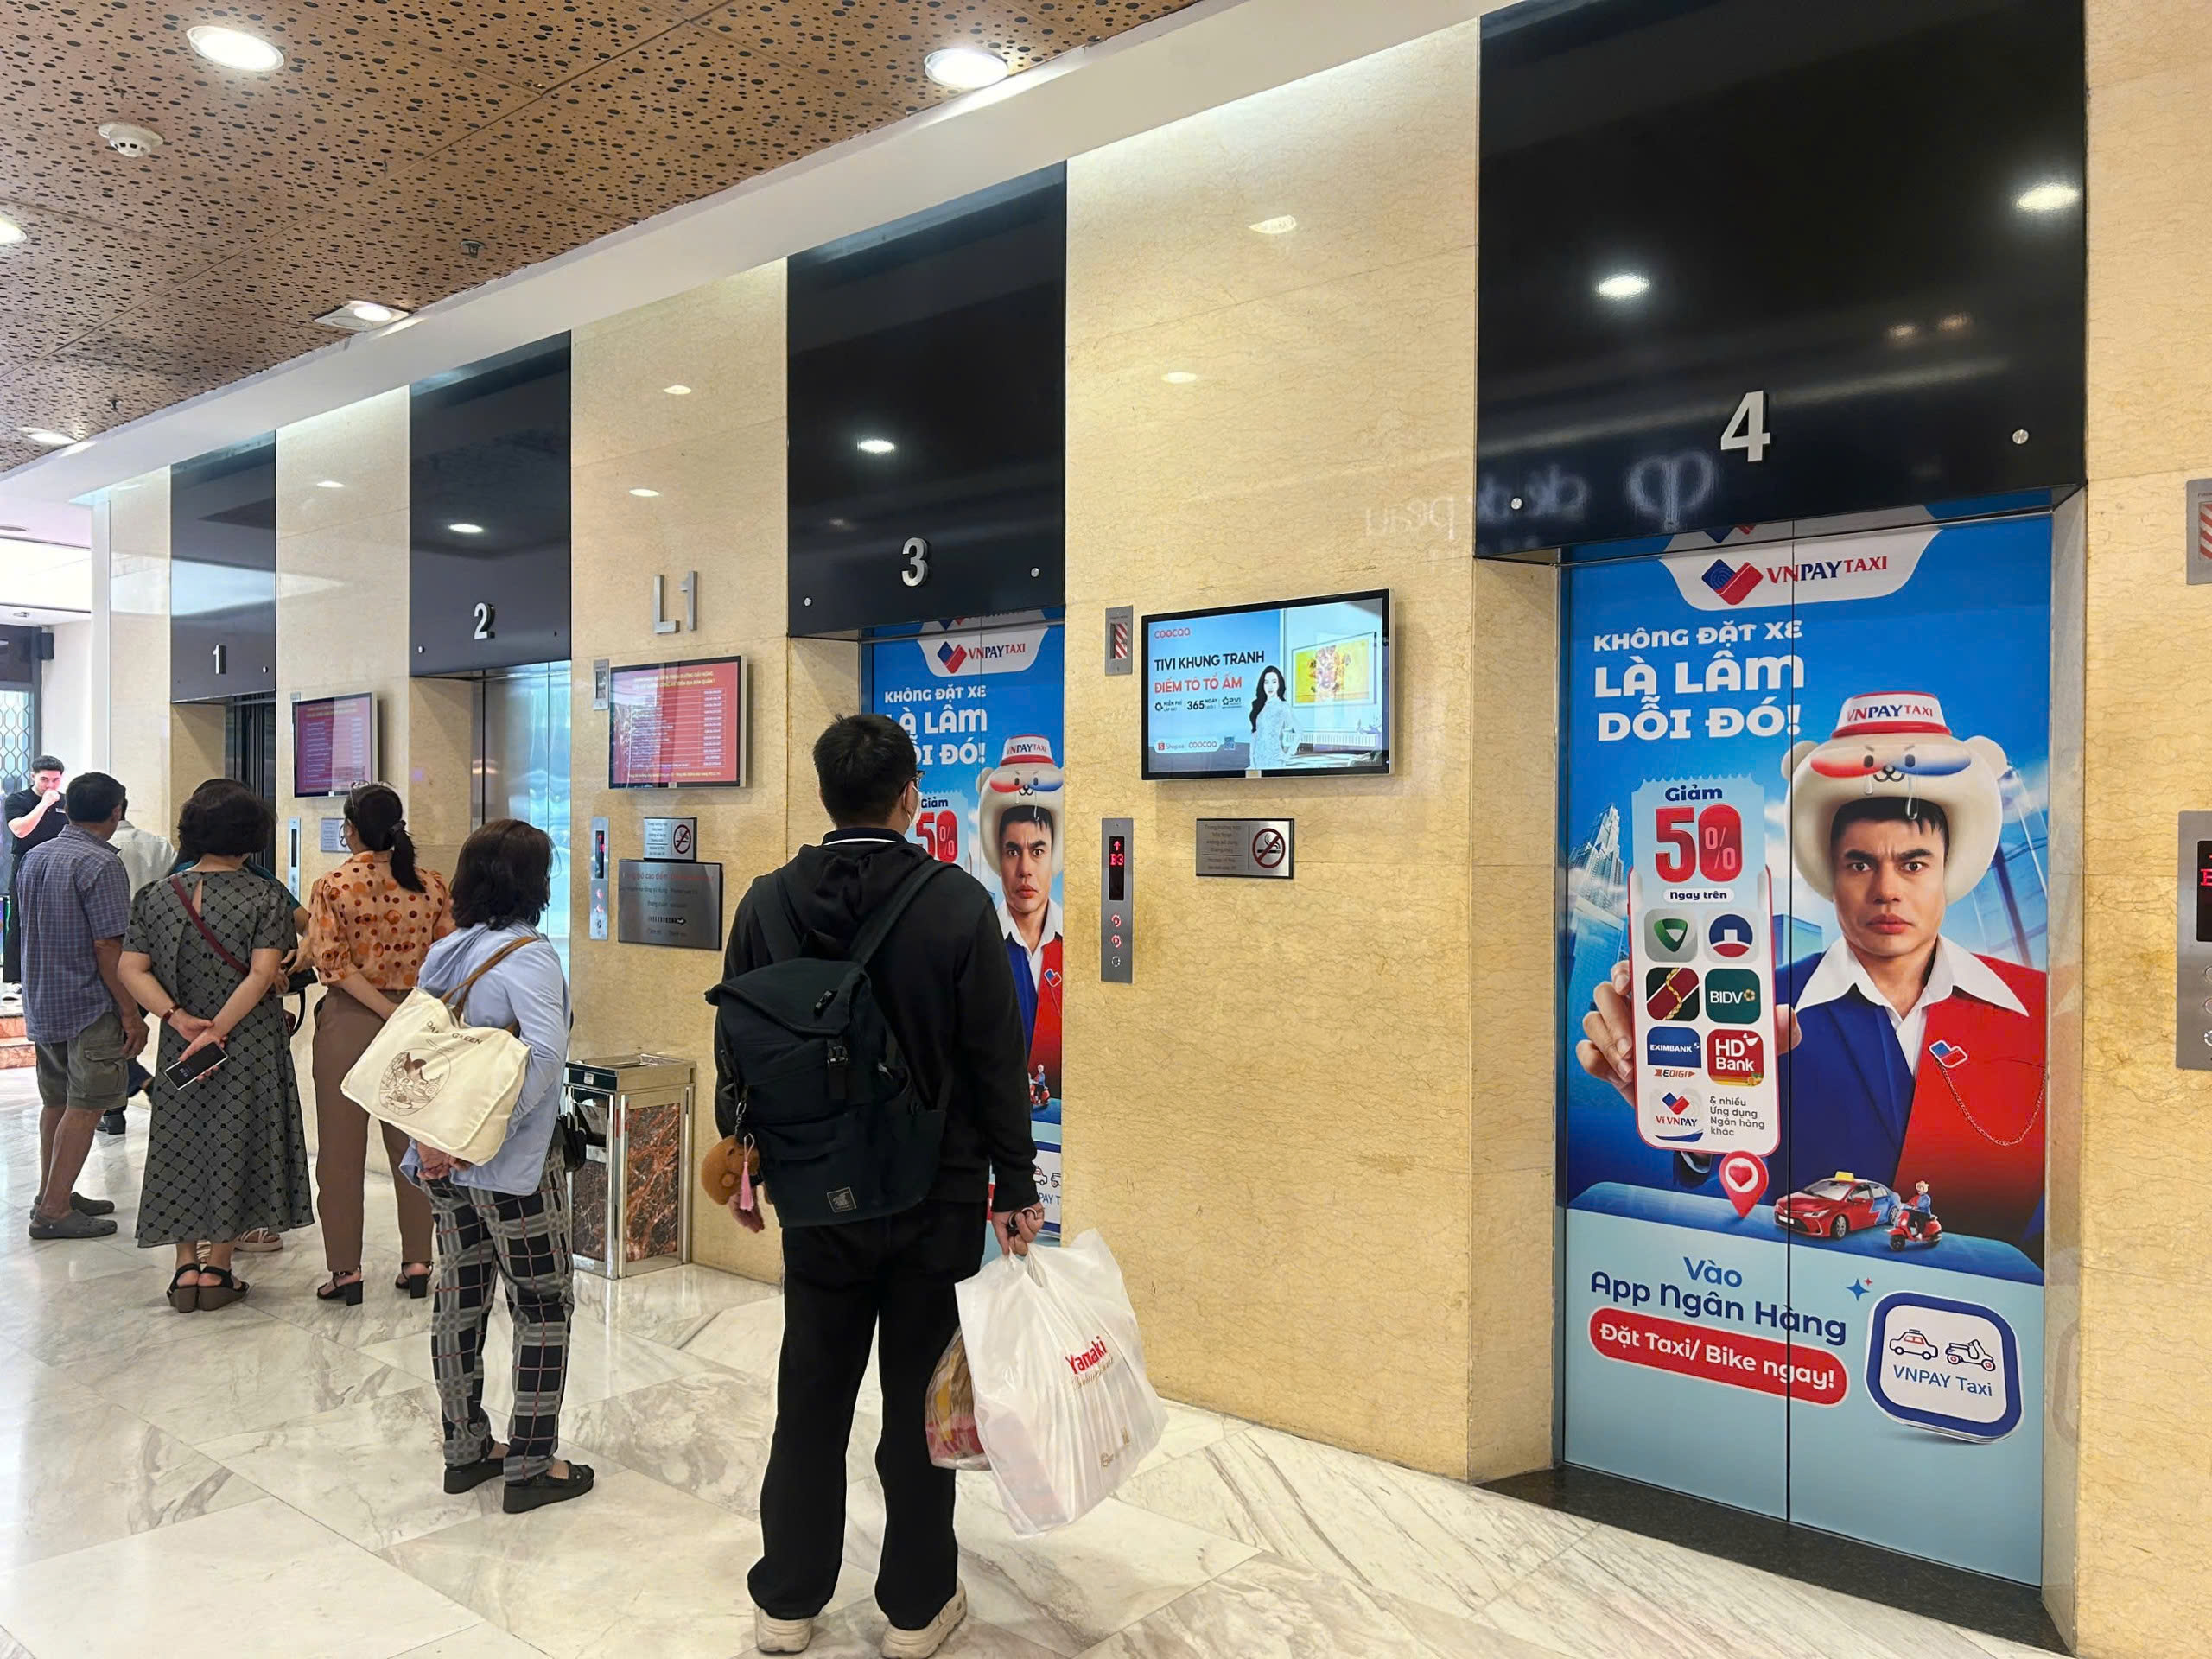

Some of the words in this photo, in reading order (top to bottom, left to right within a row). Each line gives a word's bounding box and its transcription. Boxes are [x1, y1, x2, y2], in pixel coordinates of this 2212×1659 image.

[1720, 390, 1770, 462] 4
[901, 537, 929, 588] 3
[653, 570, 698, 634] L1
[474, 602, 495, 640] 2
[1696, 620, 1757, 647] ĐẶT
[213, 645, 227, 675] 1
[1154, 658, 1176, 671] TIVI
[1179, 654, 1220, 669] KHUNG
[1223, 650, 1265, 665] TRANH
[1594, 656, 1657, 698] LÀ
[935, 683, 964, 702] ĐẶT
[1187, 700, 1205, 710] 365
[1598, 695, 1692, 741] DỖI
[1705, 696, 1802, 738] ĐÓ!
[939, 737, 986, 765] ĐÓ!
[1665, 784, 1723, 801] Giảm
[1110, 853, 1124, 866] B3
[1670, 891, 1700, 900] Ngay
[1703, 891, 1727, 899] trên
[1710, 991, 1743, 1004] BIDV
[1649, 1045, 1693, 1053] EXIMBANK
[1715, 1039, 1745, 1058] HD
[1716, 1057, 1755, 1071] Bank
[1710, 1096, 1717, 1104] &
[1668, 1117, 1697, 1127] VNPAY
[1710, 1104, 1729, 1117] Ứng
[1732, 1107, 1758, 1119] dụng
[1711, 1116, 1737, 1129] Ngân
[1739, 1116, 1764, 1130] hàng
[1711, 1127, 1734, 1136] khác
[1683, 1256, 1743, 1287] Vào
[1591, 1271, 1651, 1306] App
[1660, 1283, 1744, 1321] Ngân
[1755, 1300, 1847, 1346] Hàng
[1065, 1335, 1108, 1375] Yanaki
[1599, 1322, 1640, 1348] Đặt
[1706, 1344, 1757, 1371] Bike
[1764, 1361, 1834, 1390] ngay!
[1893, 1364, 1951, 1388] VNPAY
[1955, 1376, 1993, 1396] Taxi
